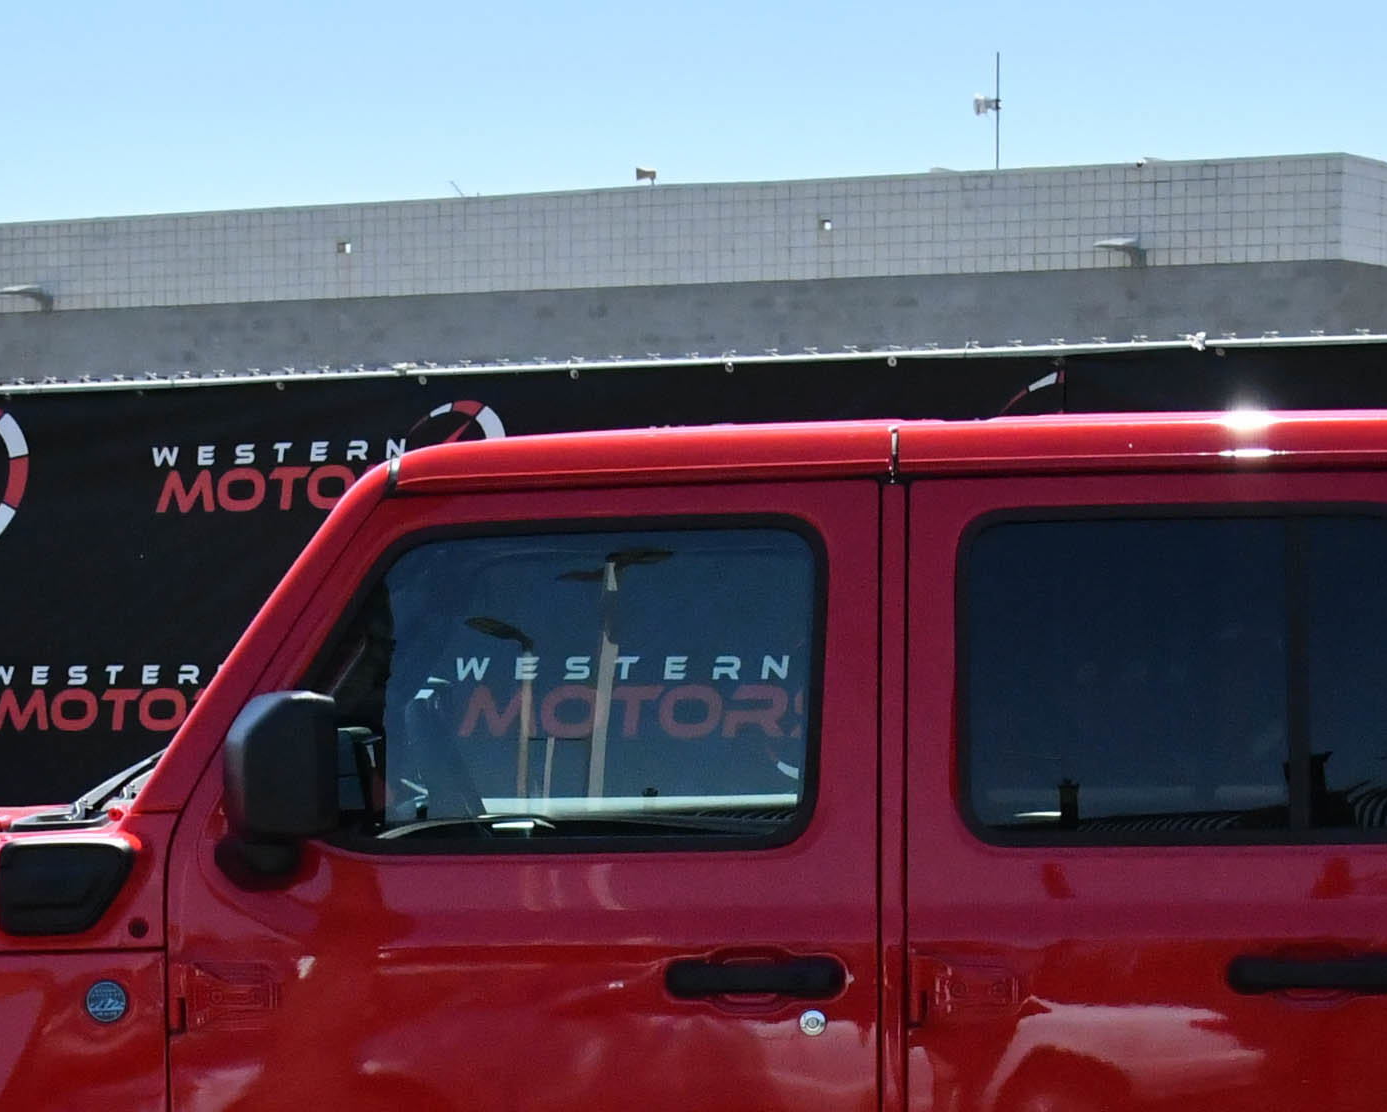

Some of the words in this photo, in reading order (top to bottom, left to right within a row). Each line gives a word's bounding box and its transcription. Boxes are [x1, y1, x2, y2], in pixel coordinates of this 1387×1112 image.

[153, 439, 407, 468] WESTERN
[156, 464, 377, 514] MOTO
[456, 656, 790, 682] WESTERN
